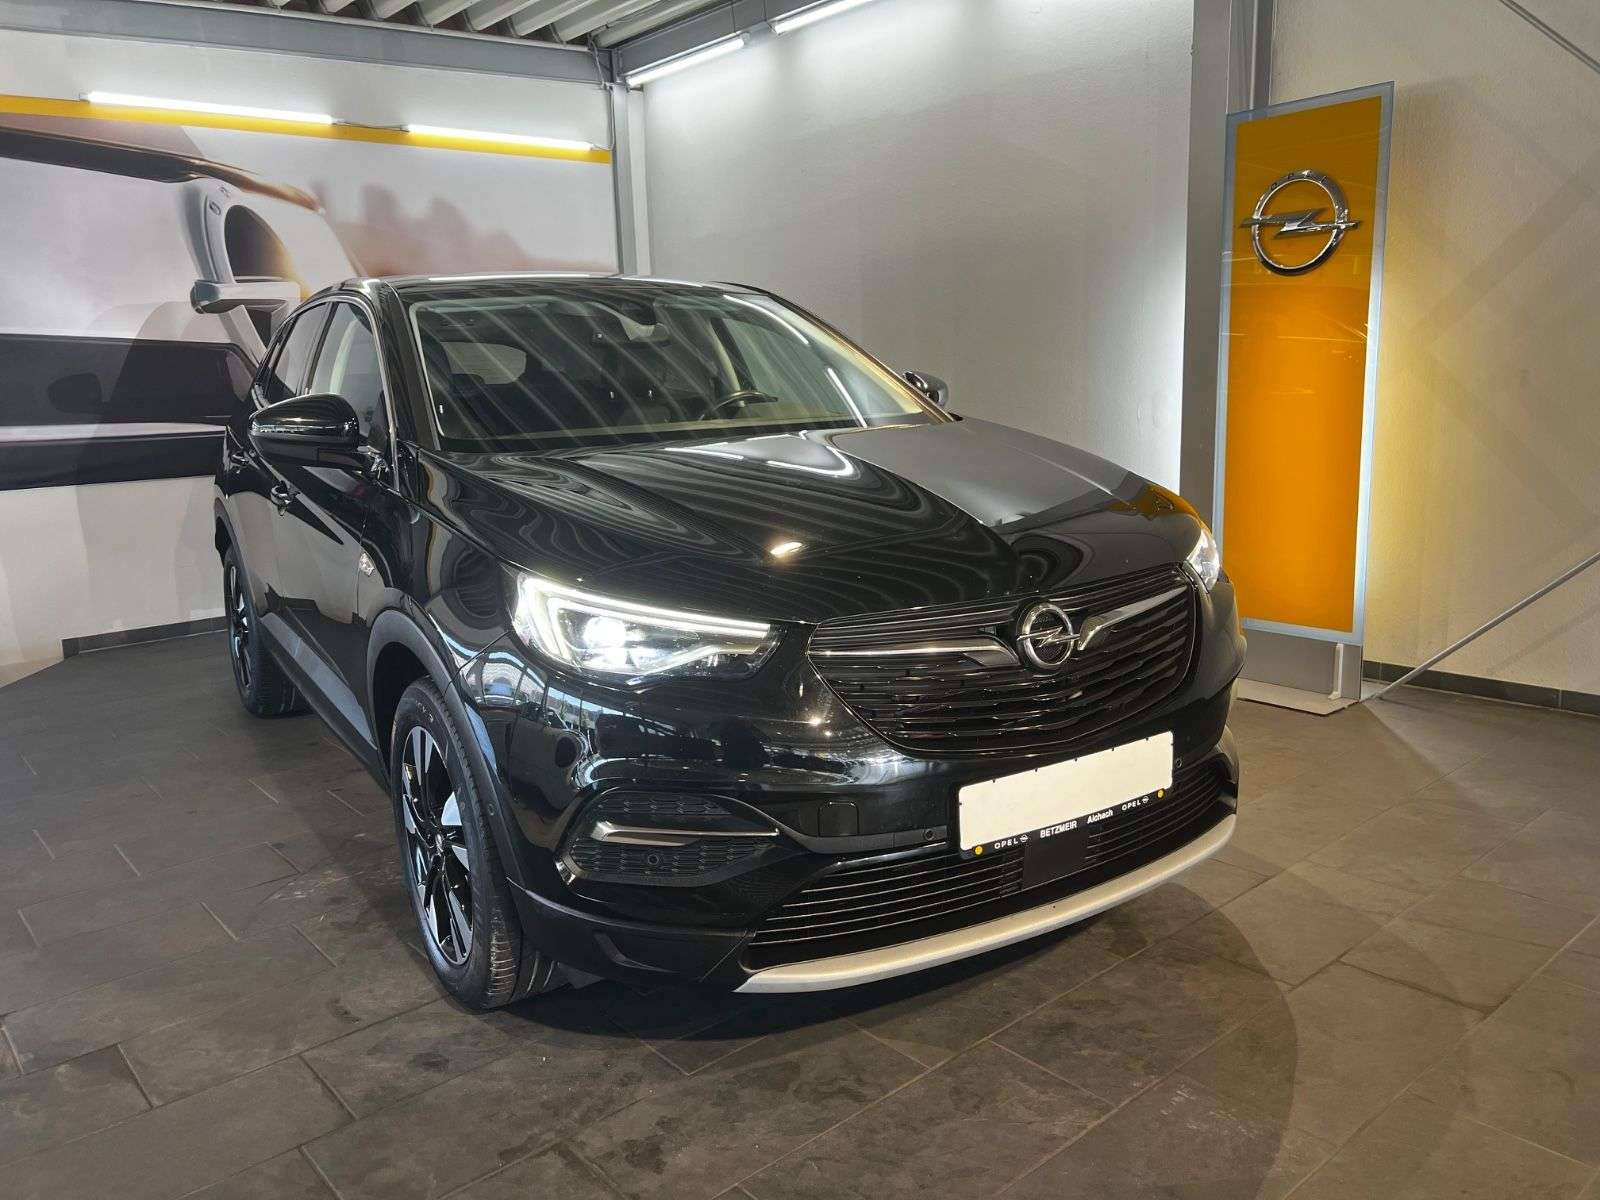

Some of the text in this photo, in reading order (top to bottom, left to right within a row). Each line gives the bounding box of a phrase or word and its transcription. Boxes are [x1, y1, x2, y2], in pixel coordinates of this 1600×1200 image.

[994, 838, 1019, 850] OPEL
[1040, 820, 1077, 839] BETZMEIR
[1121, 800, 1142, 811] OPEL
